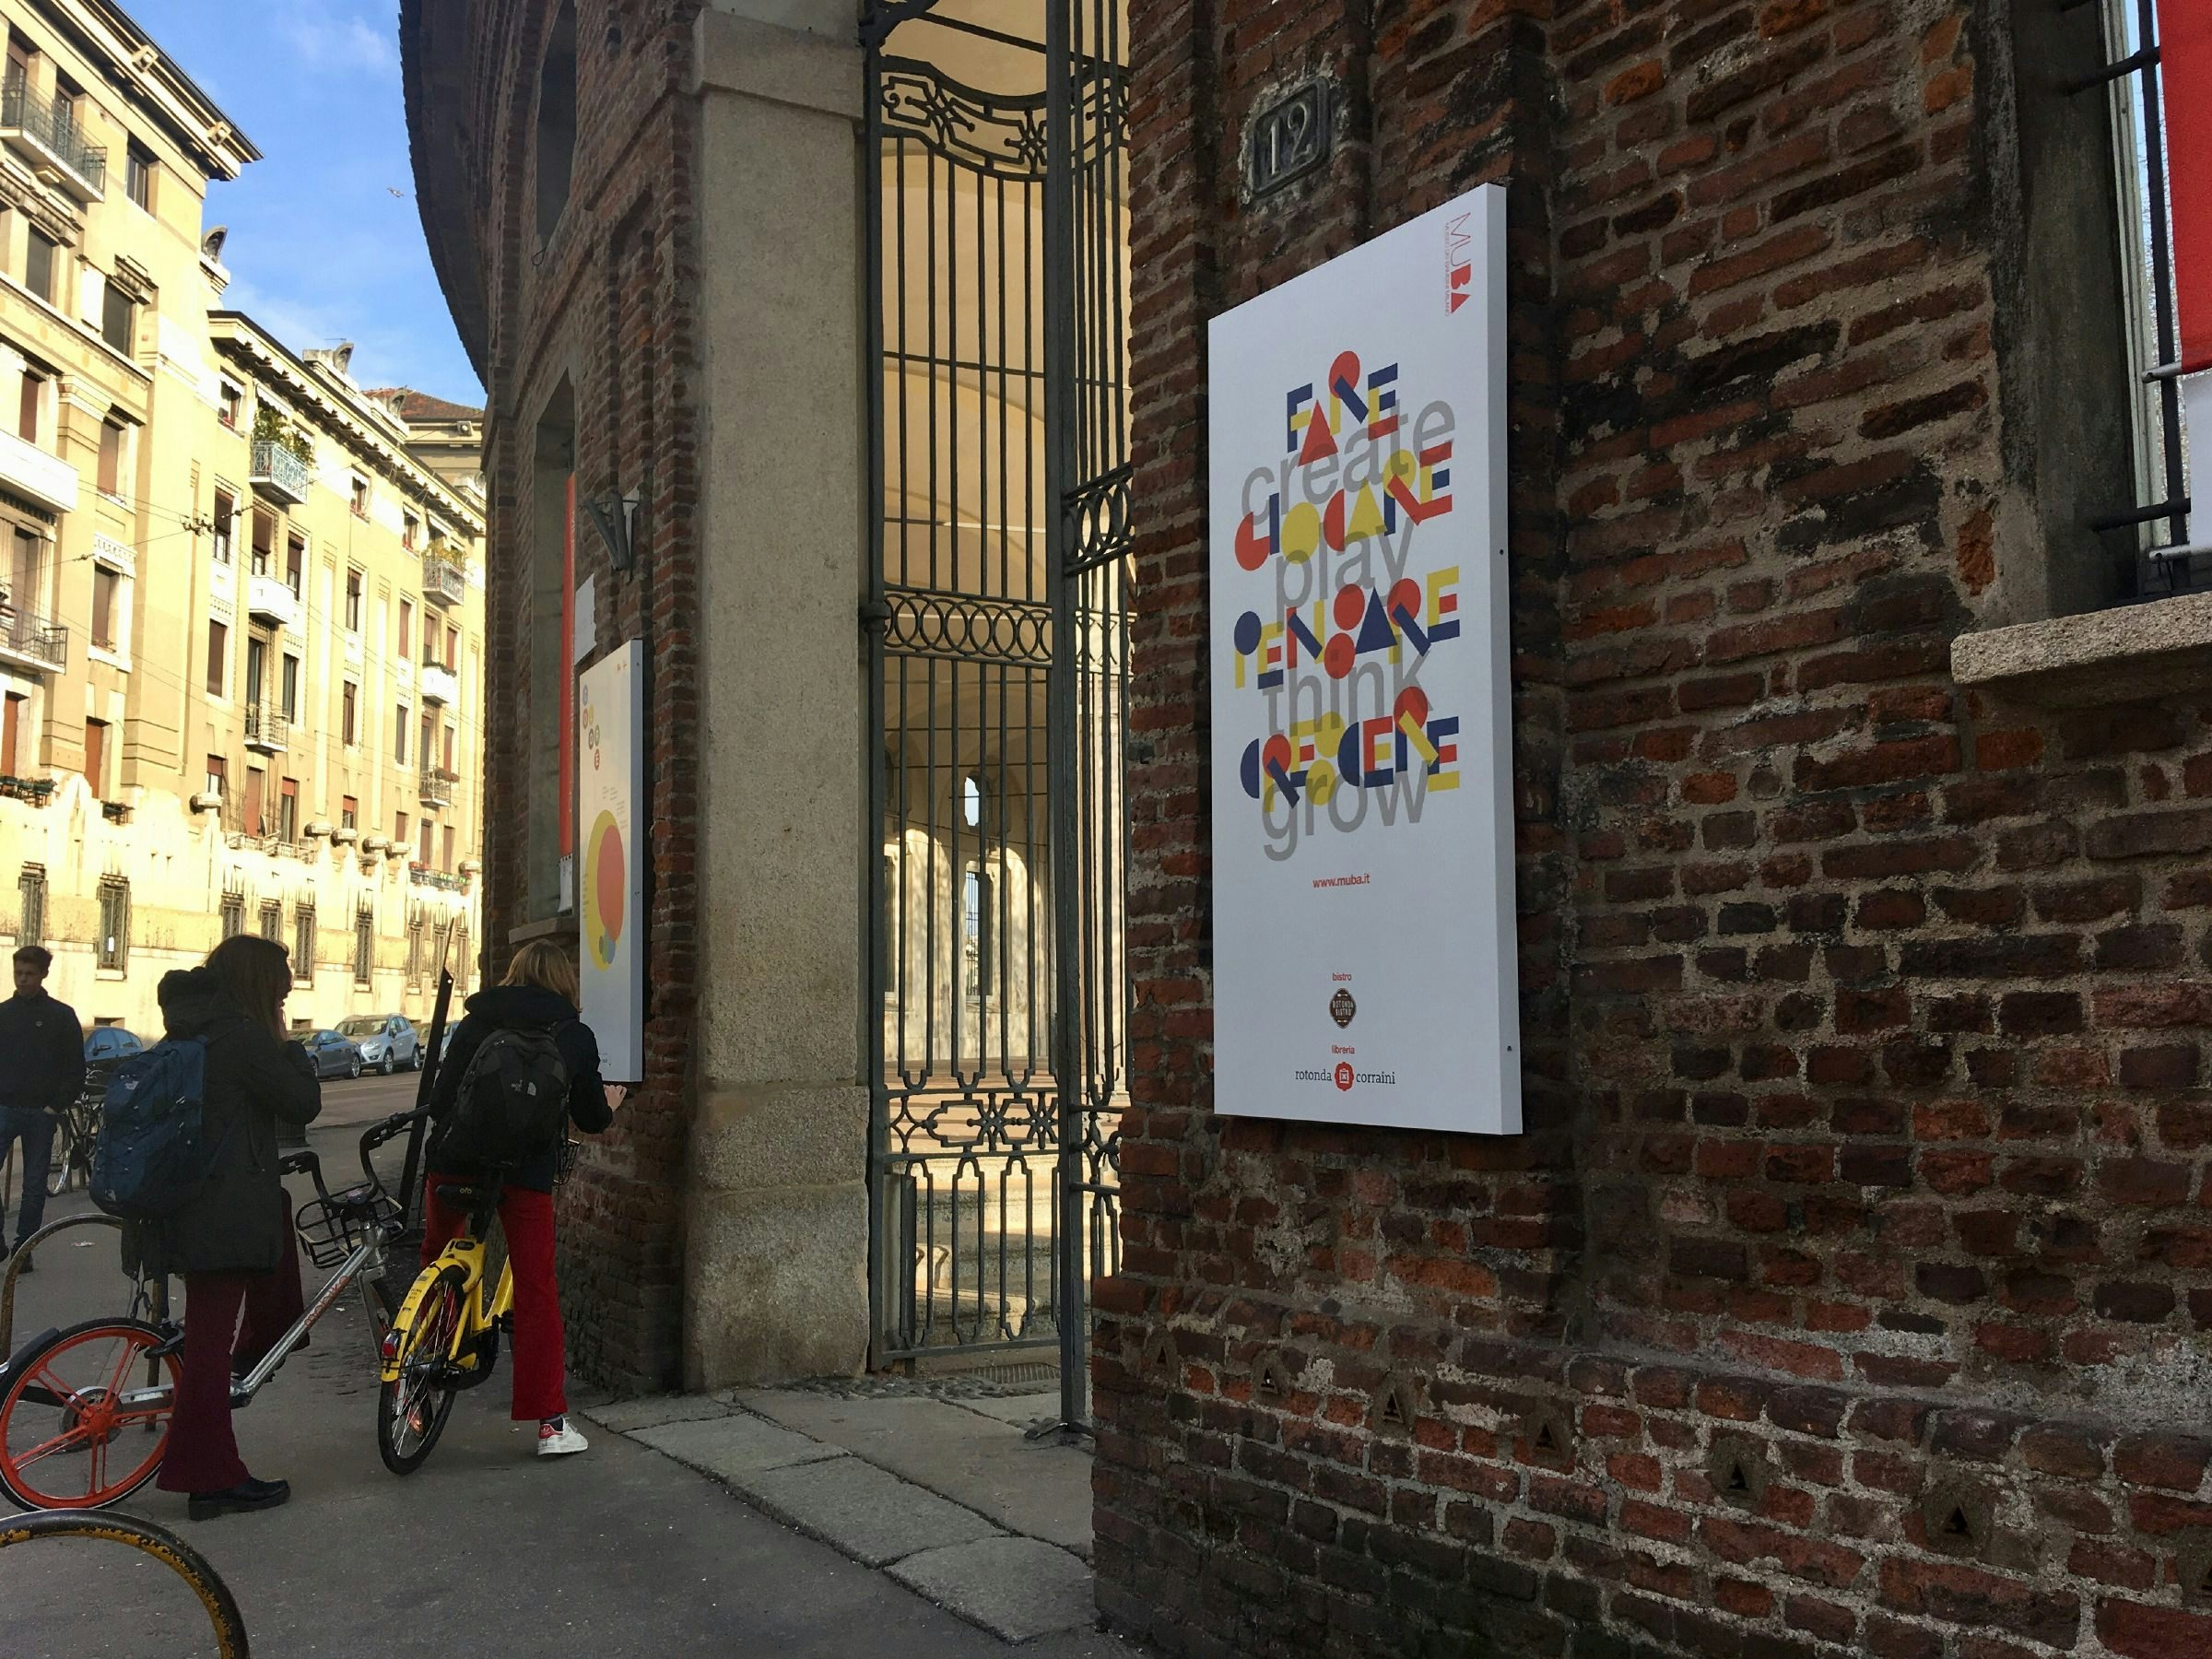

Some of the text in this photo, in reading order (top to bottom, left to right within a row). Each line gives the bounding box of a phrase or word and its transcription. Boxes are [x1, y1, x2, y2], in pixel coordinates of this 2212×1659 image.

[1267, 100, 1313, 176] 12
[1450, 211, 1472, 314] MUBA
[1286, 350, 1399, 467] FARE
[1234, 441, 1453, 571] GIOCARE
[1241, 398, 1456, 526] create
[1275, 516, 1415, 632] play
[1233, 565, 1461, 689] PENSARE
[1262, 633, 1434, 737] think
[1240, 686, 1461, 813] CRESCERE
[1261, 759, 1432, 862] grow
[1312, 873, 1371, 888] www.muba.it
[1332, 972, 1352, 982] bistro
[1295, 1069, 1396, 1085] rotonda corraini
[1331, 1044, 1356, 1054] libreria
[459, 1186, 473, 1194] ofo
